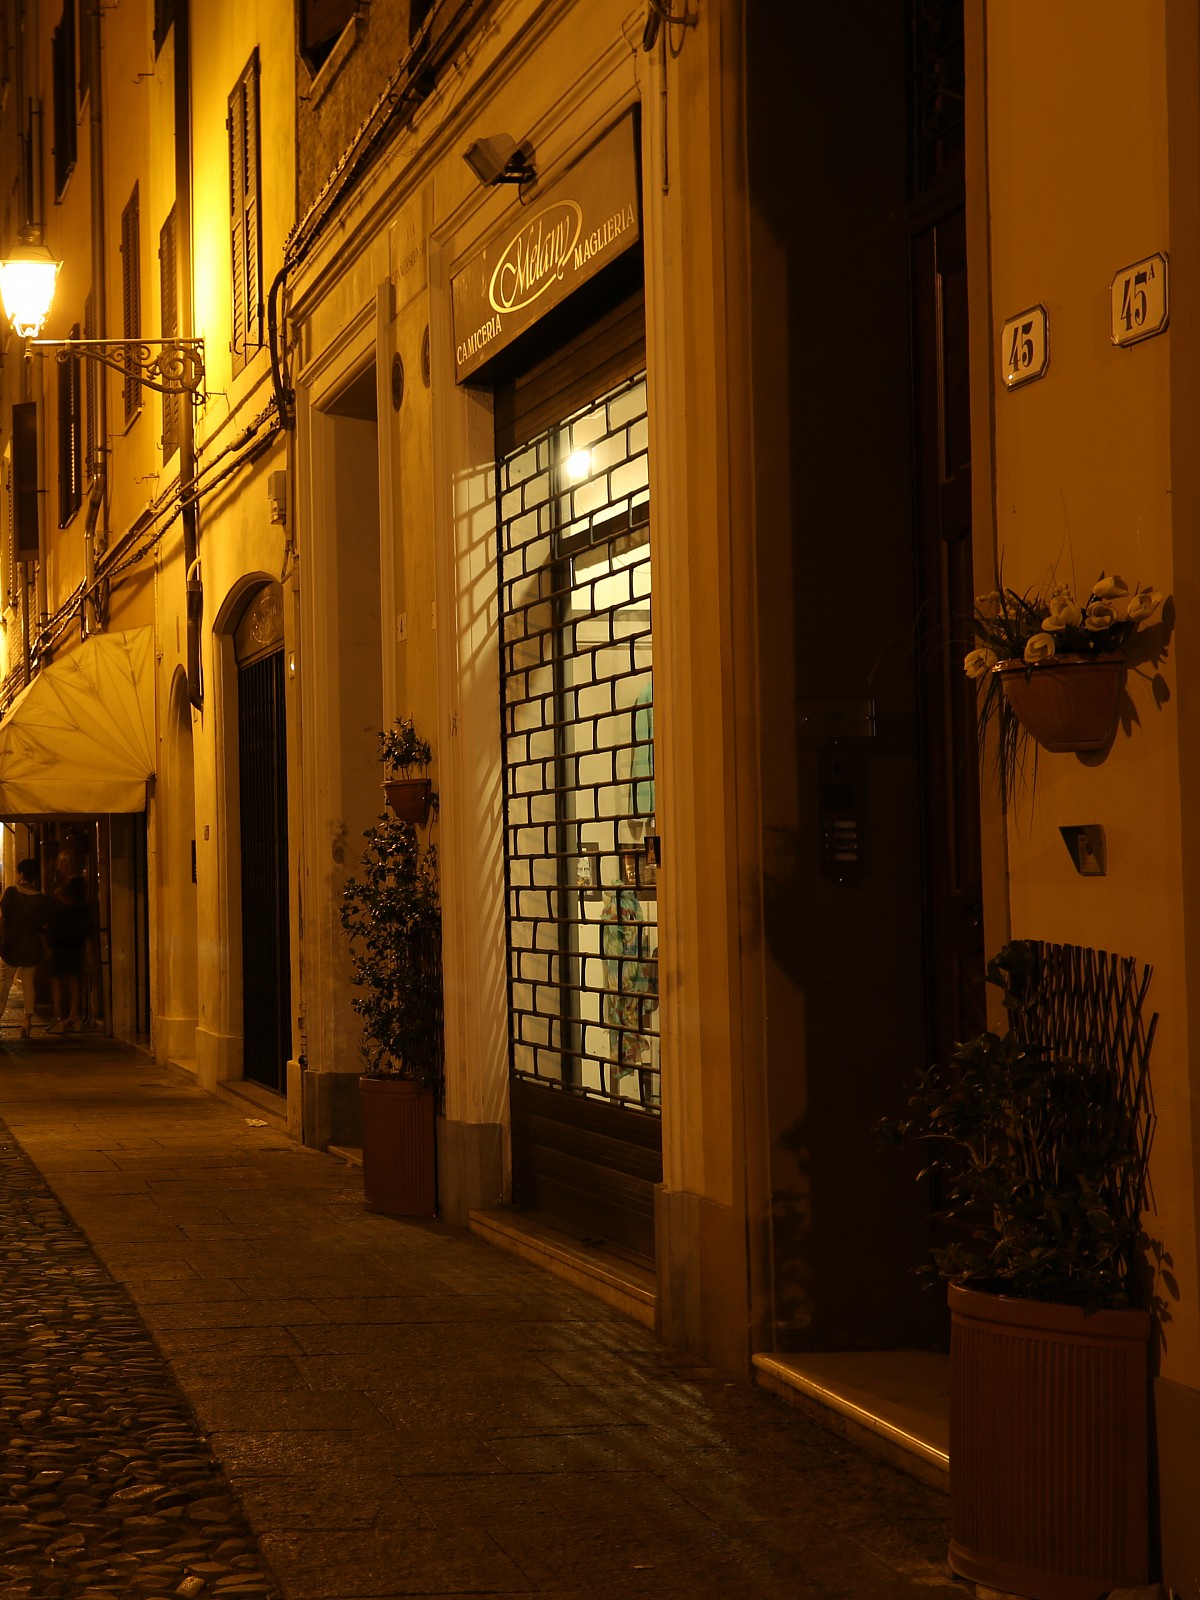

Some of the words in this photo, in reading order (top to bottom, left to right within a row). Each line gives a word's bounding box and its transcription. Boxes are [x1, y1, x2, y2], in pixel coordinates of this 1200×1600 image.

[574, 204, 635, 270] MAGLIERIA
[456, 314, 502, 366] CAMICERIA
[1009, 320, 1034, 373] 45
